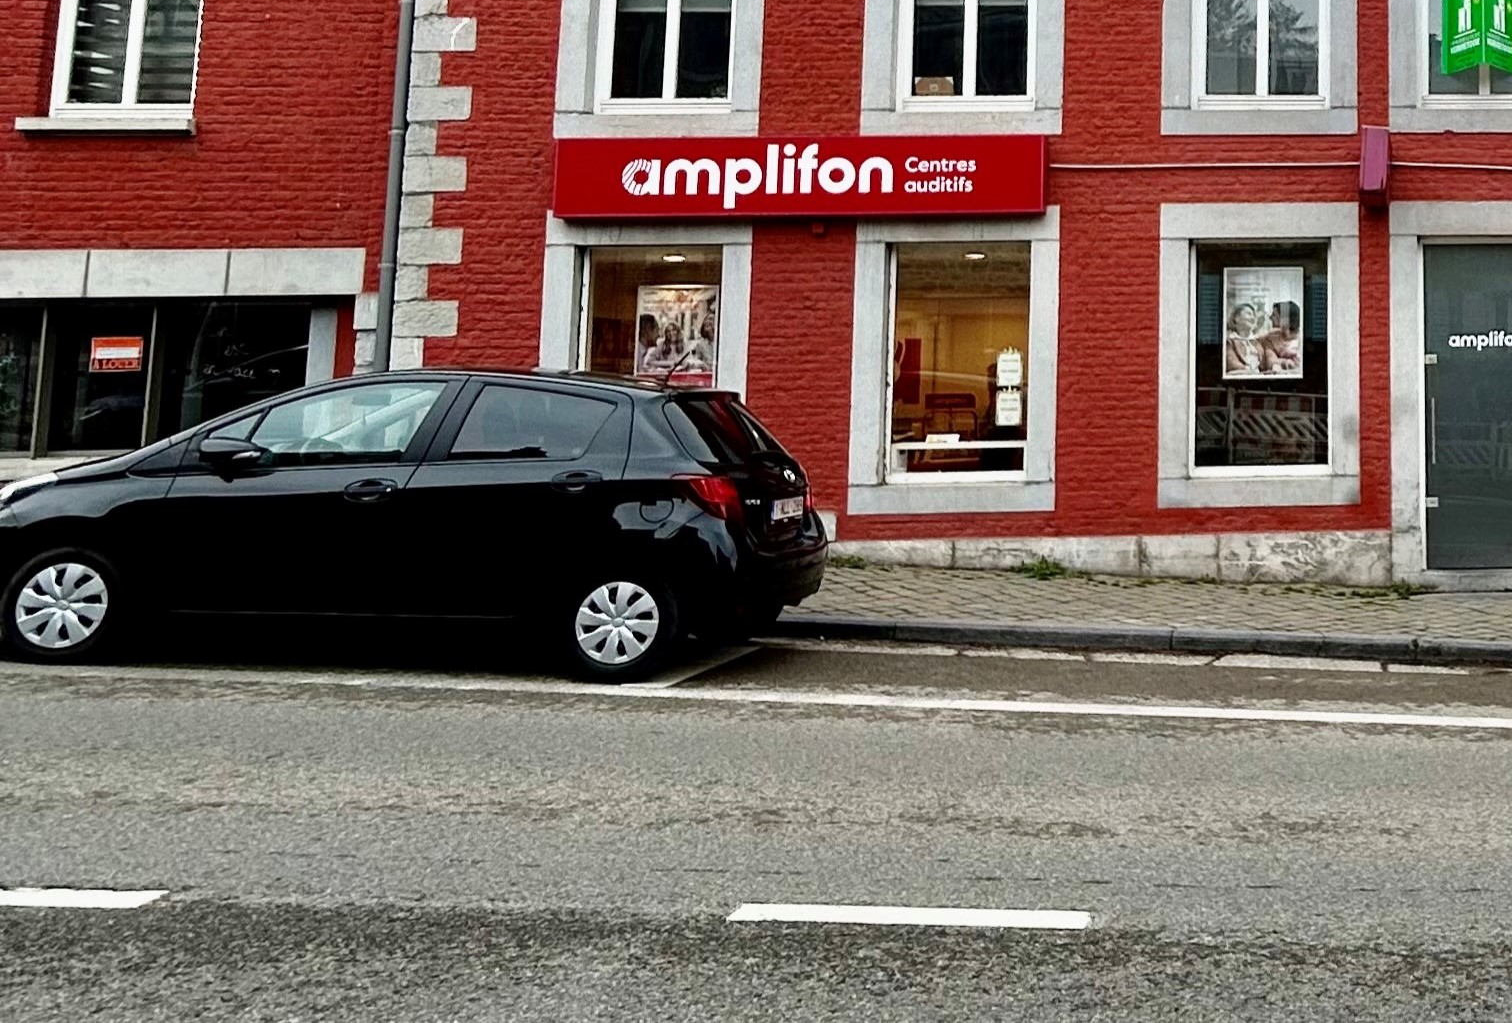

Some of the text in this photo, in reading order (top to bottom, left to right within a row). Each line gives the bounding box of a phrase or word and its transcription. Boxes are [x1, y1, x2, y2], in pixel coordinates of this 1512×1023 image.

[904, 157, 976, 173] Centres
[622, 143, 893, 209] amplifon
[904, 177, 973, 193] auditifs
